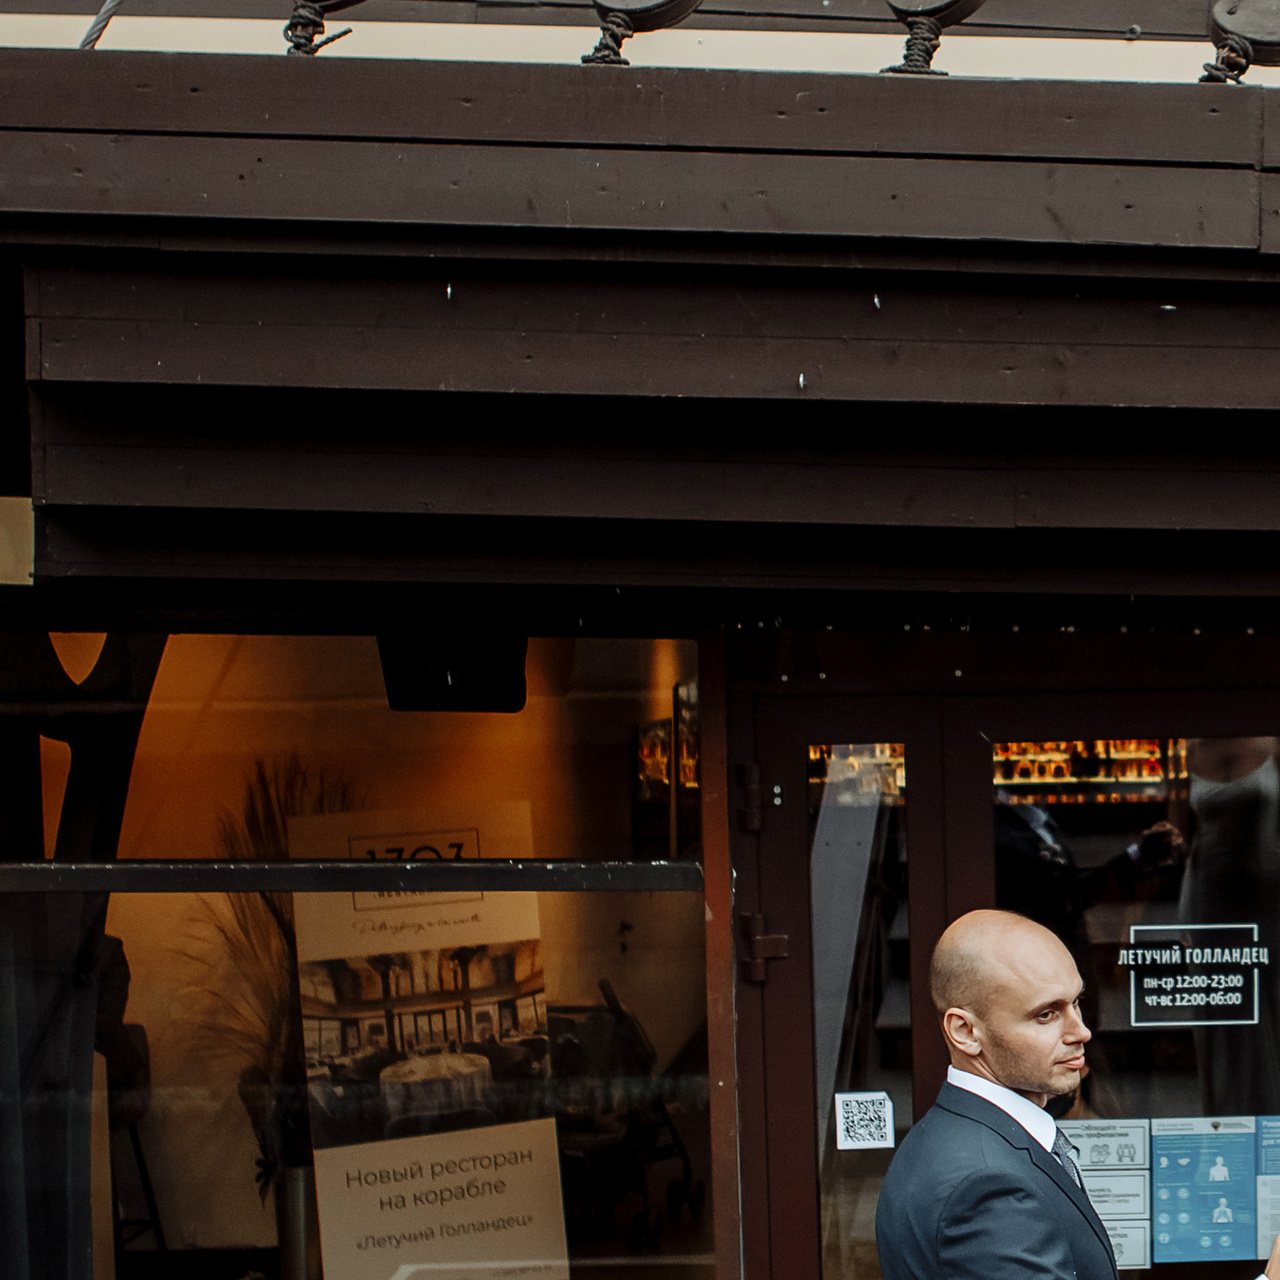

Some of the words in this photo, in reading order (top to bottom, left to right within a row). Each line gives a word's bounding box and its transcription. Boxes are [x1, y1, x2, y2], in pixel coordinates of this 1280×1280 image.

[1118, 945, 1181, 965] ЛЕТУЧИЙ
[1185, 948, 1269, 965] ГОЛЛАНДЕЦ
[1143, 977, 1174, 990] пн-ср
[1176, 975, 1243, 989] 12:00-23:00
[1145, 994, 1173, 1006] чт-вс
[1175, 992, 1242, 1006] 12:00-06:00
[345, 1161, 423, 1189] Новый
[430, 1149, 533, 1180] ресторан
[379, 1194, 407, 1211] на
[413, 1178, 507, 1207] корабле
